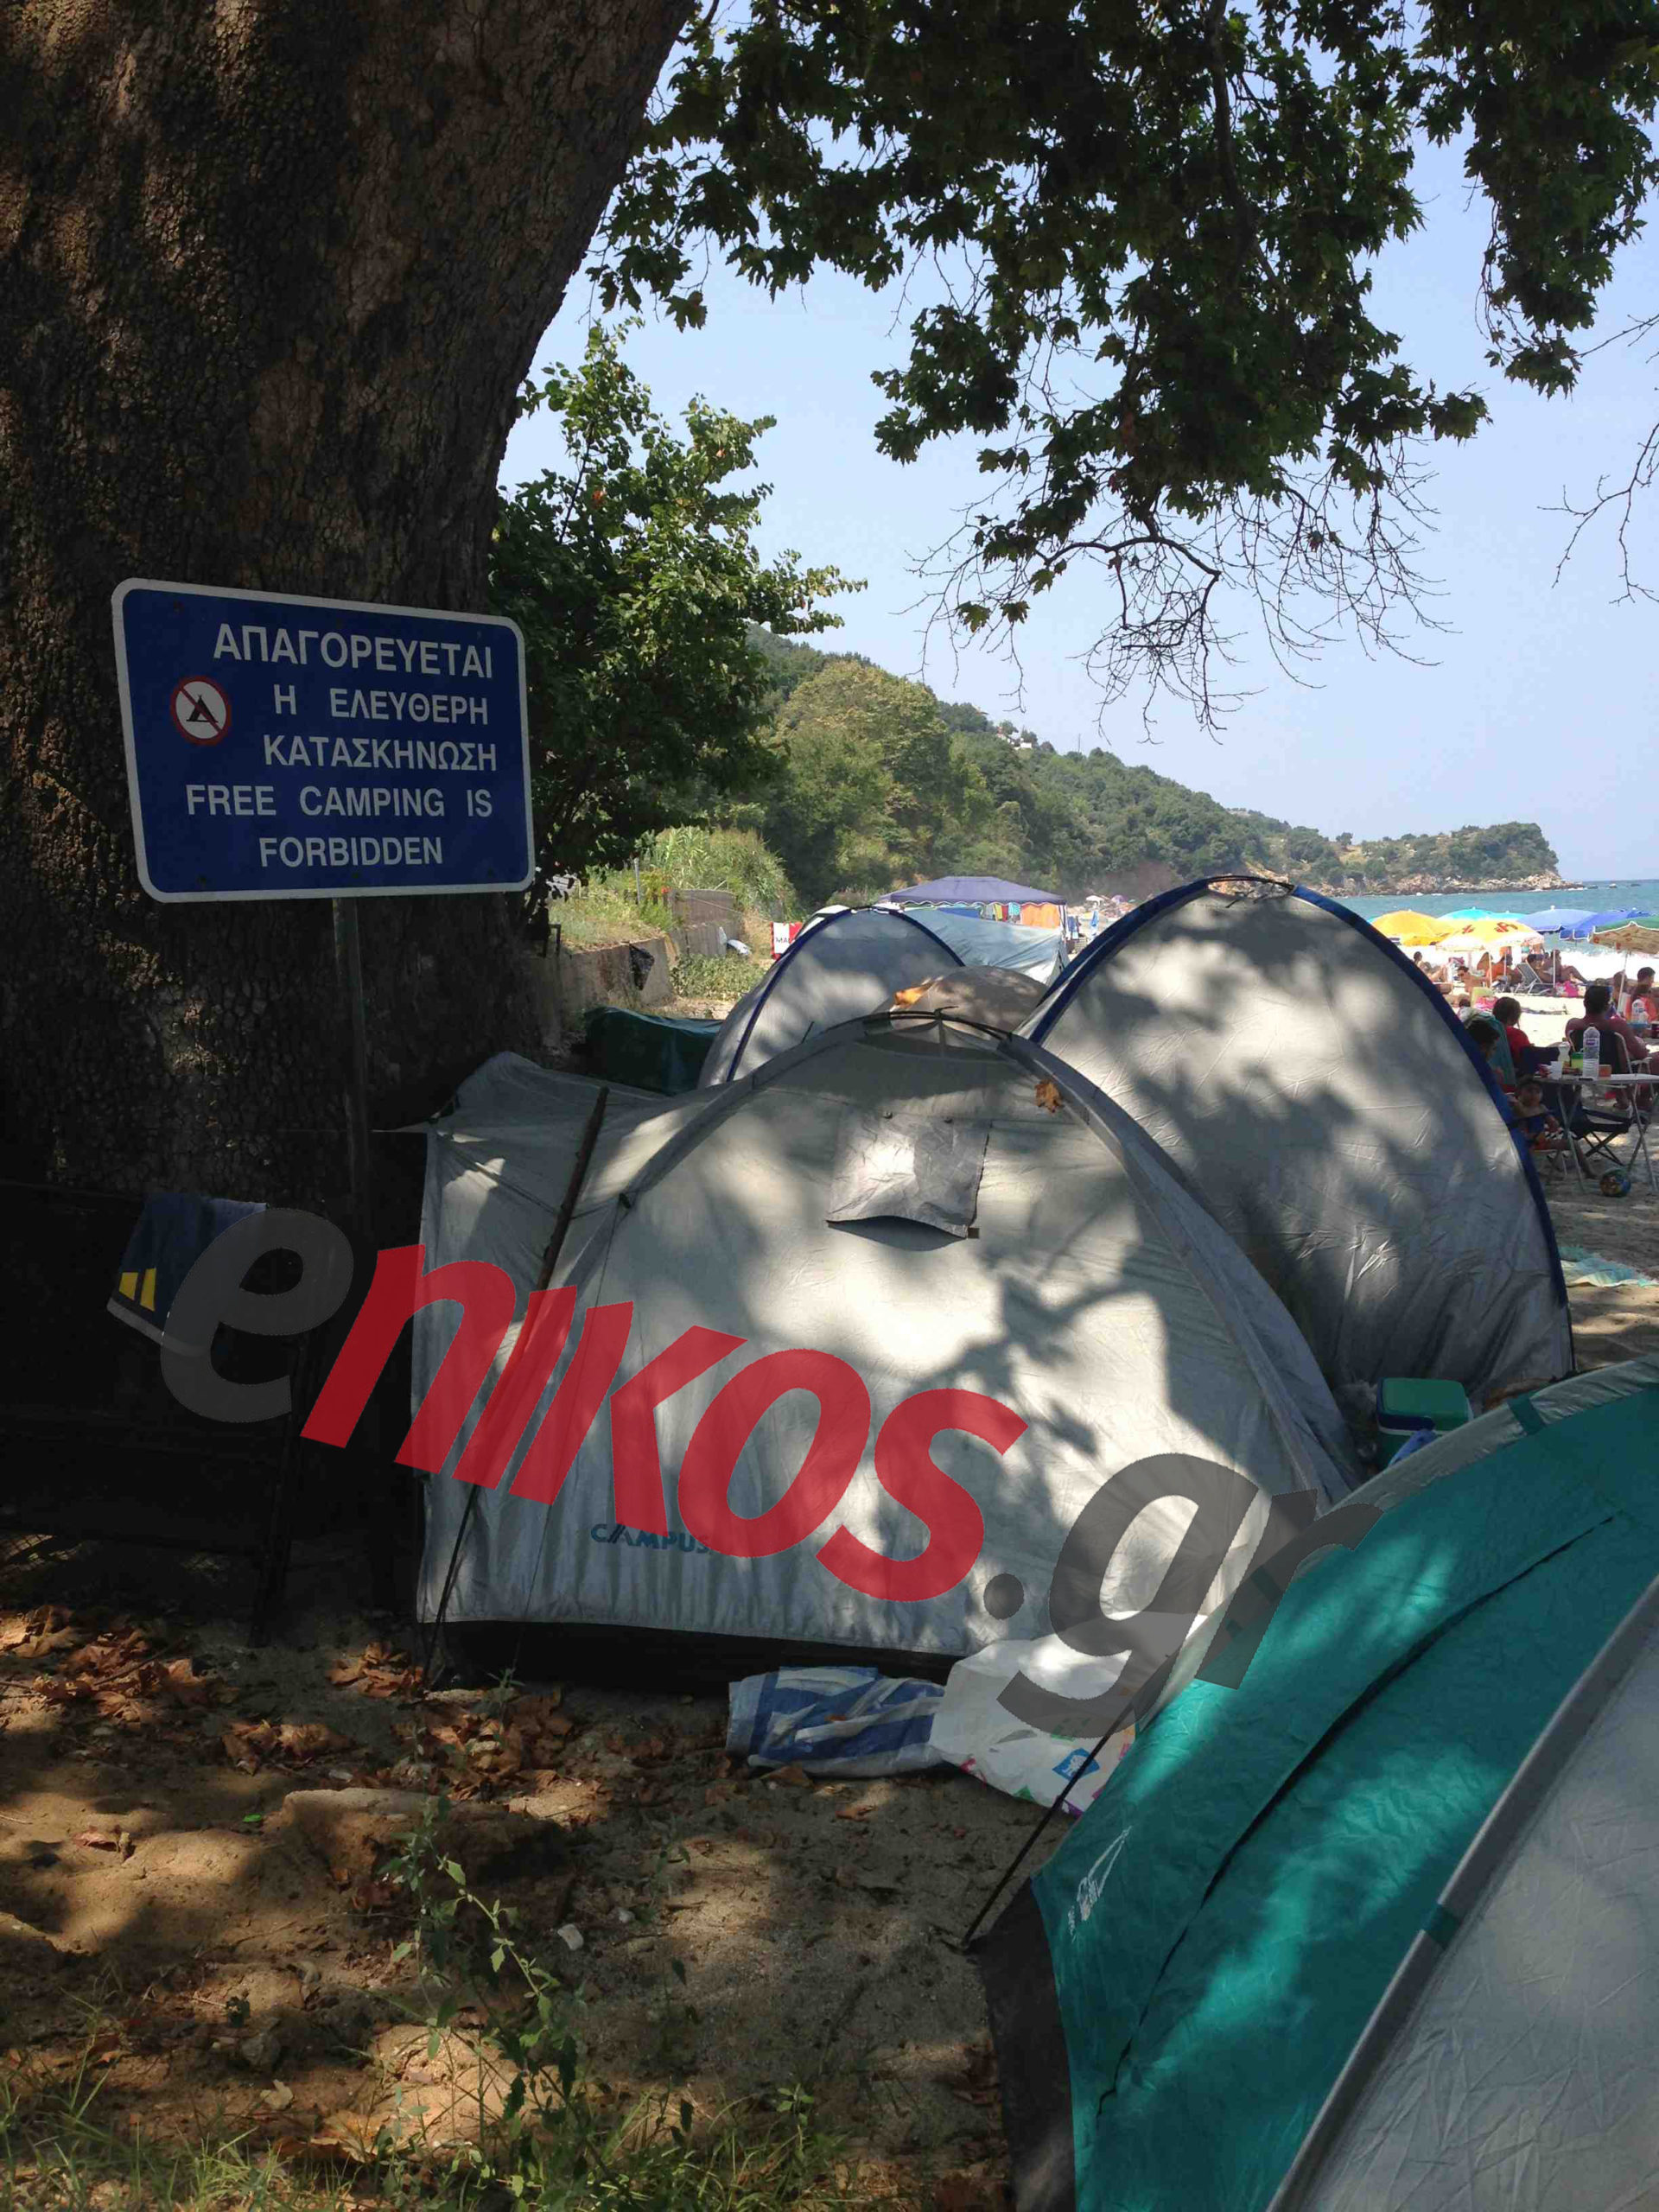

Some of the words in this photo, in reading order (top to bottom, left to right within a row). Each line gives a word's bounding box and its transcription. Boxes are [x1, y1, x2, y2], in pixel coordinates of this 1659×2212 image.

[213, 623, 493, 678] ΑΠΑΓΟΡΕΥΕΤΑΙ
[275, 684, 297, 715] Η
[330, 689, 488, 725] ΕΛΕΥΘΕΡΗ
[264, 734, 497, 772] ΚΑΤΑΣΚΗΝΩΣΗ
[186, 785, 276, 816] FREE
[299, 785, 445, 817] CAMPING
[467, 789, 493, 817] IS
[259, 837, 443, 868] FORBIDDEN
